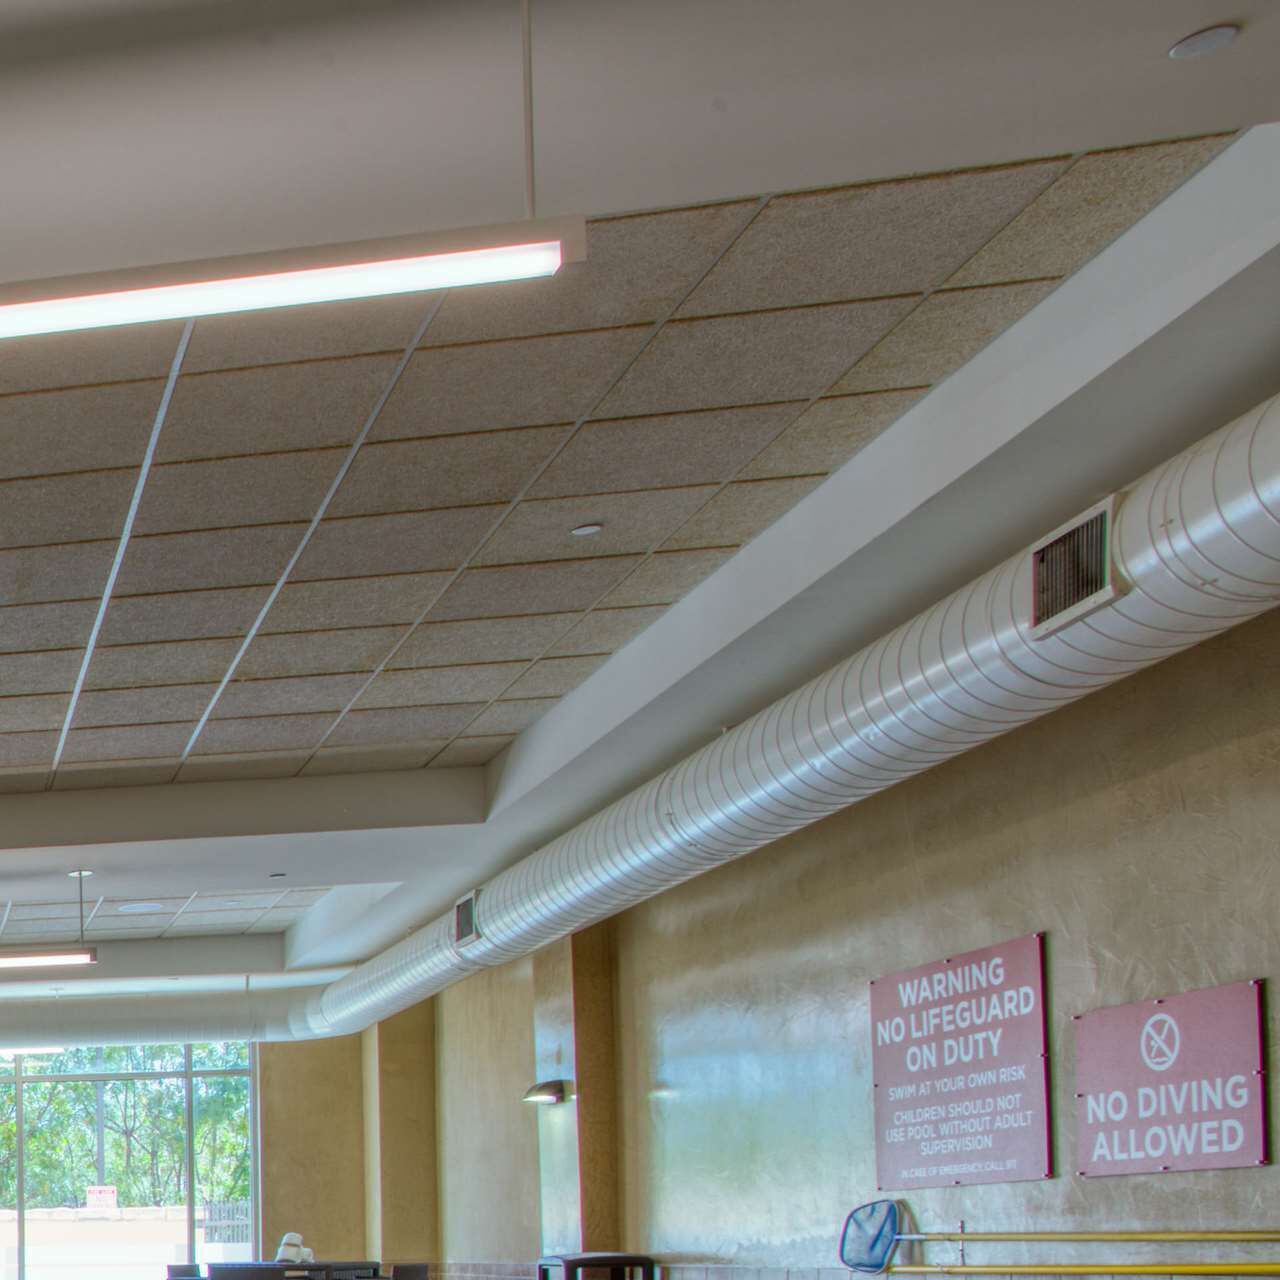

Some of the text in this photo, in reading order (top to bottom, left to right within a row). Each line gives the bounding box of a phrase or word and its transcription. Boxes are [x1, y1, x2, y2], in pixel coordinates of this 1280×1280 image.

[898, 957, 1005, 1009] WARNING
[876, 985, 1035, 1047] NO LIFEGUARD
[906, 1028, 1003, 1073] ON DUTY
[888, 1065, 1026, 1102] SWIM AT YOUR OWN RISK
[1087, 1075, 1249, 1125] NO DIVING
[886, 1110, 1033, 1144] USE POOL WITHOUT ADULT
[893, 1093, 1023, 1126] CHILDREN SHOULD NOT
[920, 1134, 993, 1156] SUPERVISION
[1091, 1118, 1245, 1163] ALLOWED
